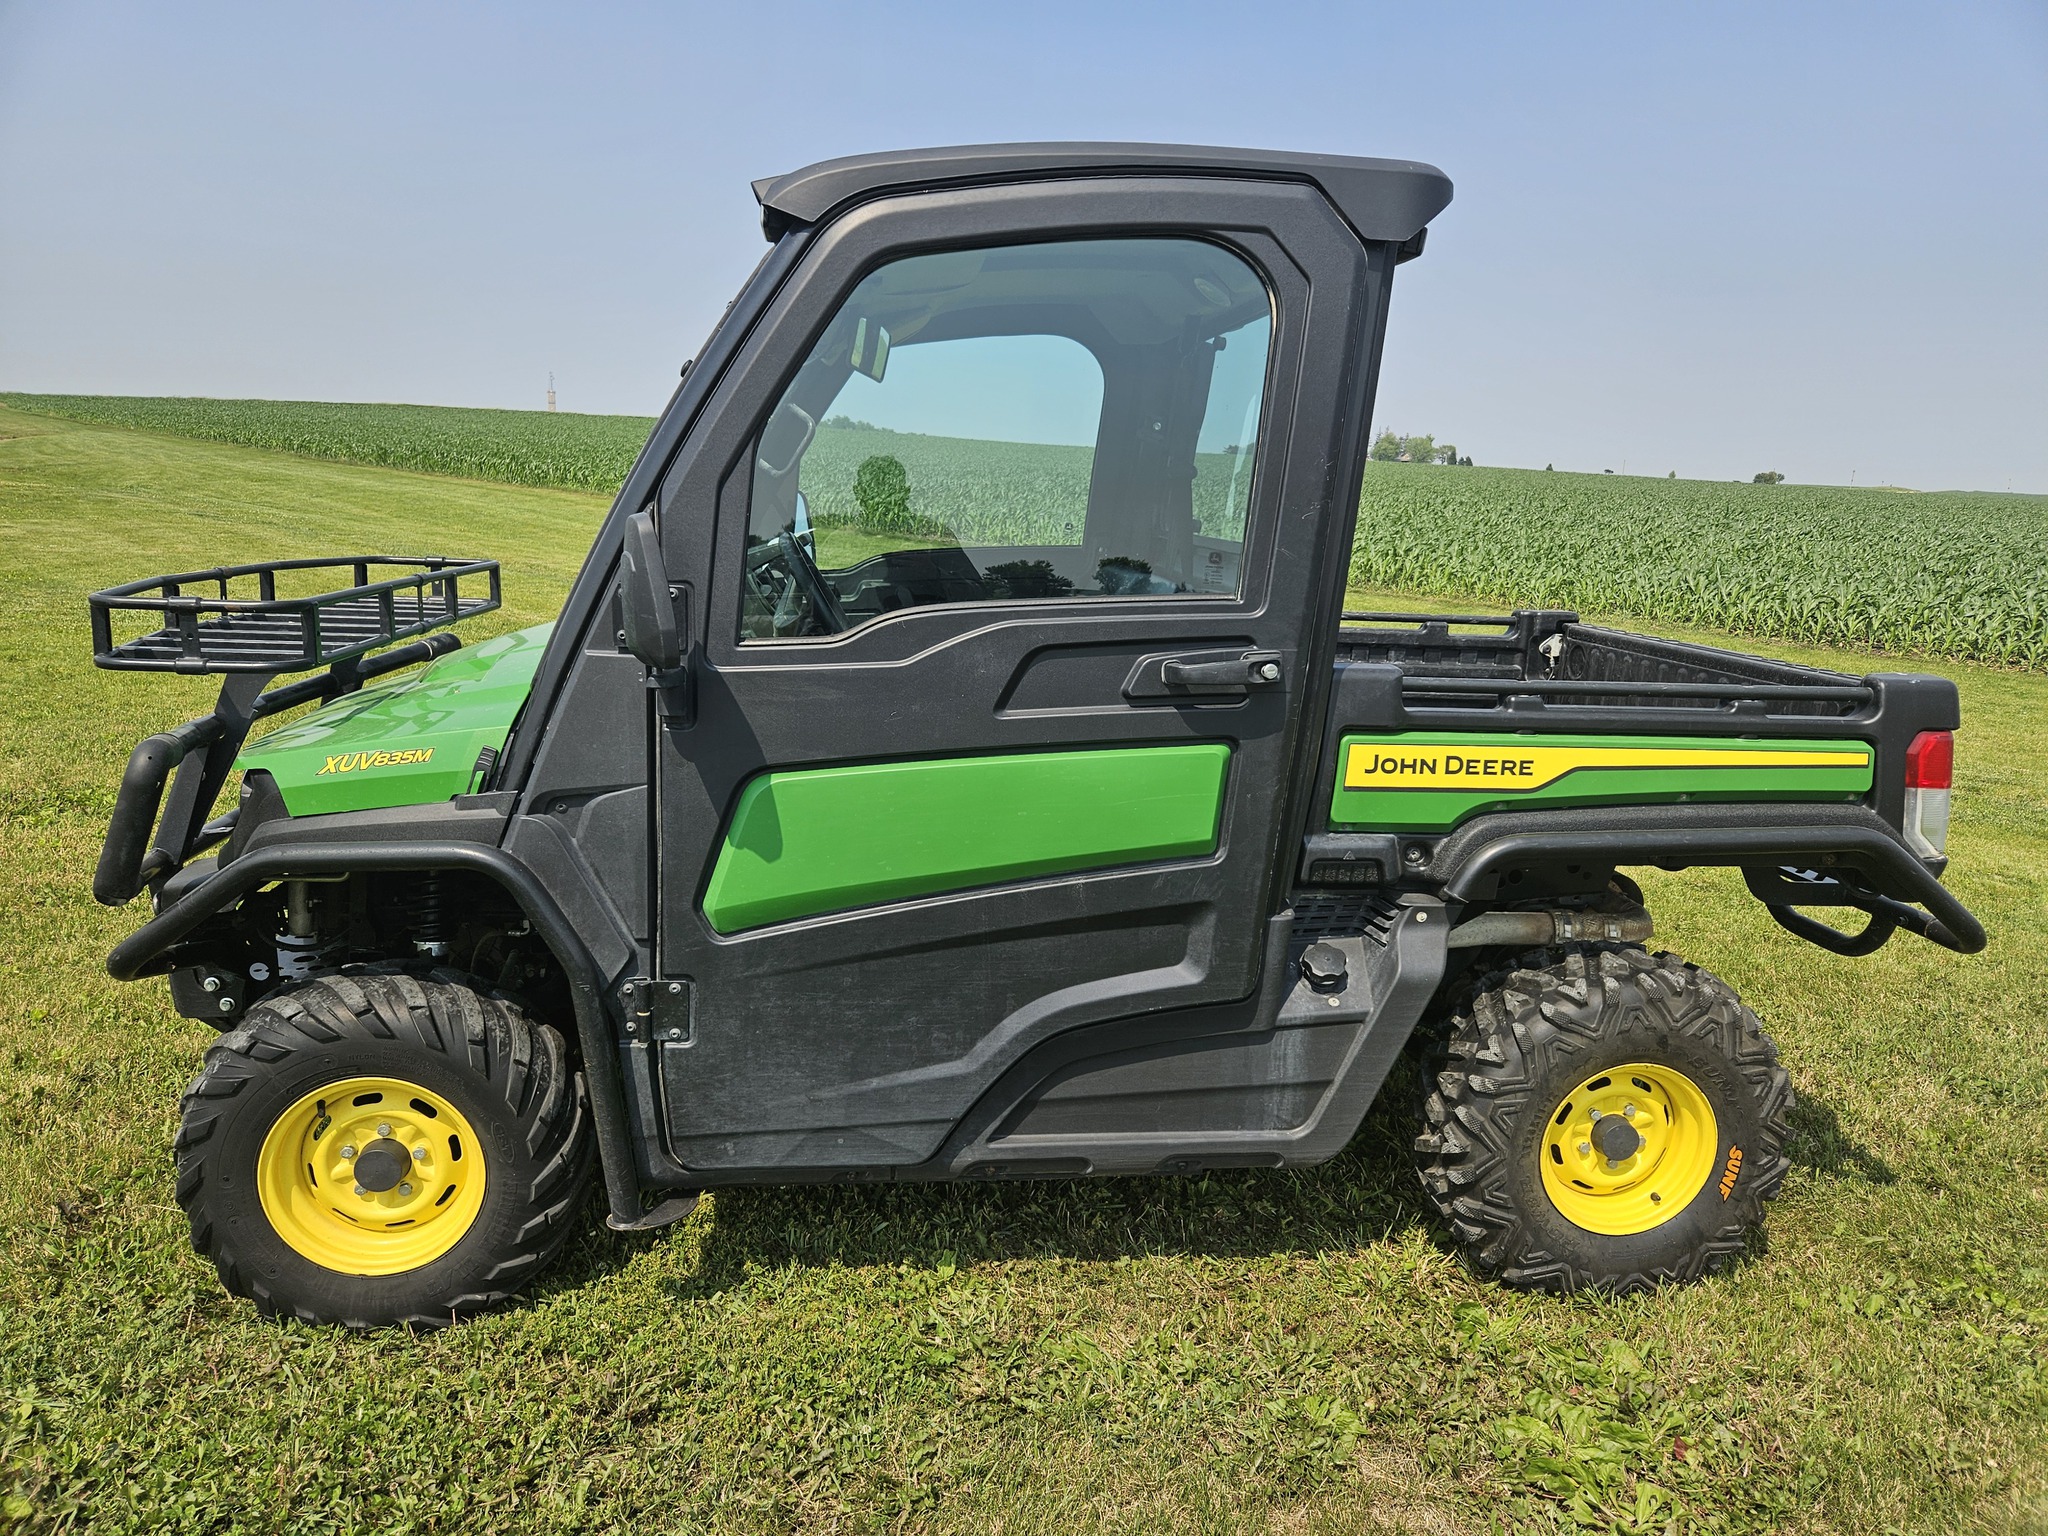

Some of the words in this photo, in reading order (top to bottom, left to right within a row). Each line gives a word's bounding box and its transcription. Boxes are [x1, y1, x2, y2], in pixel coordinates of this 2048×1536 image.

[315, 748, 435, 776] XUV835M
[1364, 754, 1437, 775] JOHN
[1445, 755, 1534, 776] DEERE
[1718, 1143, 1744, 1204] SUNF
